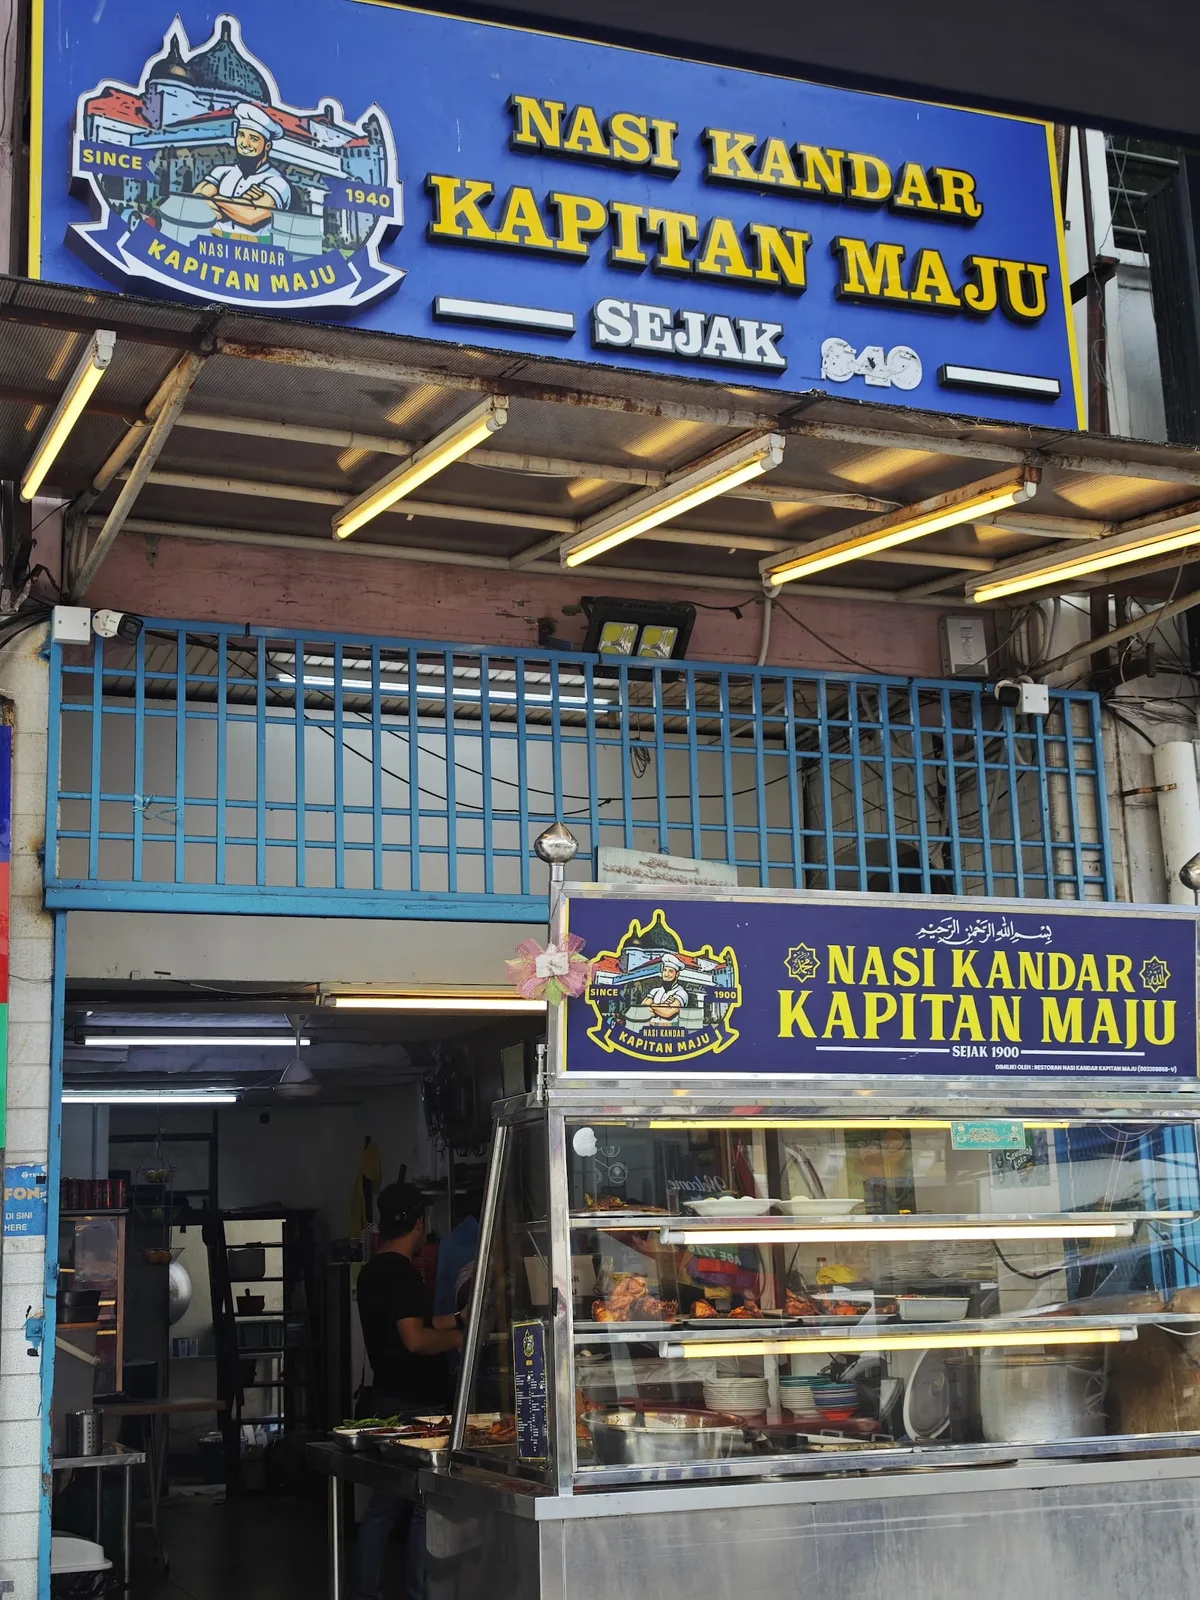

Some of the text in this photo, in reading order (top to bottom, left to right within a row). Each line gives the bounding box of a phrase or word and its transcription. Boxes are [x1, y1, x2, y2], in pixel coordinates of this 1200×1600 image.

[82, 148, 143, 170] SINCE
[511, 93, 984, 222] NASI KANDAR
[344, 188, 391, 209] 1940
[199, 240, 285, 267] NASI KANDAR
[427, 173, 1049, 321] KAPITAN MAJU
[147, 238, 337, 293] KAPITAN MAJU
[594, 298, 788, 369] SEJAK
[827, 945, 1136, 993] NASI KANDAR
[590, 988, 619, 997] SINCE
[714, 991, 737, 999] 1900
[777, 989, 1177, 1050] KAPITAN MAJU
[618, 1031, 711, 1054] KAPITAN MAJU
[643, 1028, 685, 1038] NASI KANDAR
[951, 1044, 1019, 1059] SEJAK 1900
[5, 1211, 33, 1220] DI SINI
[4, 1223, 28, 1231] HERE
